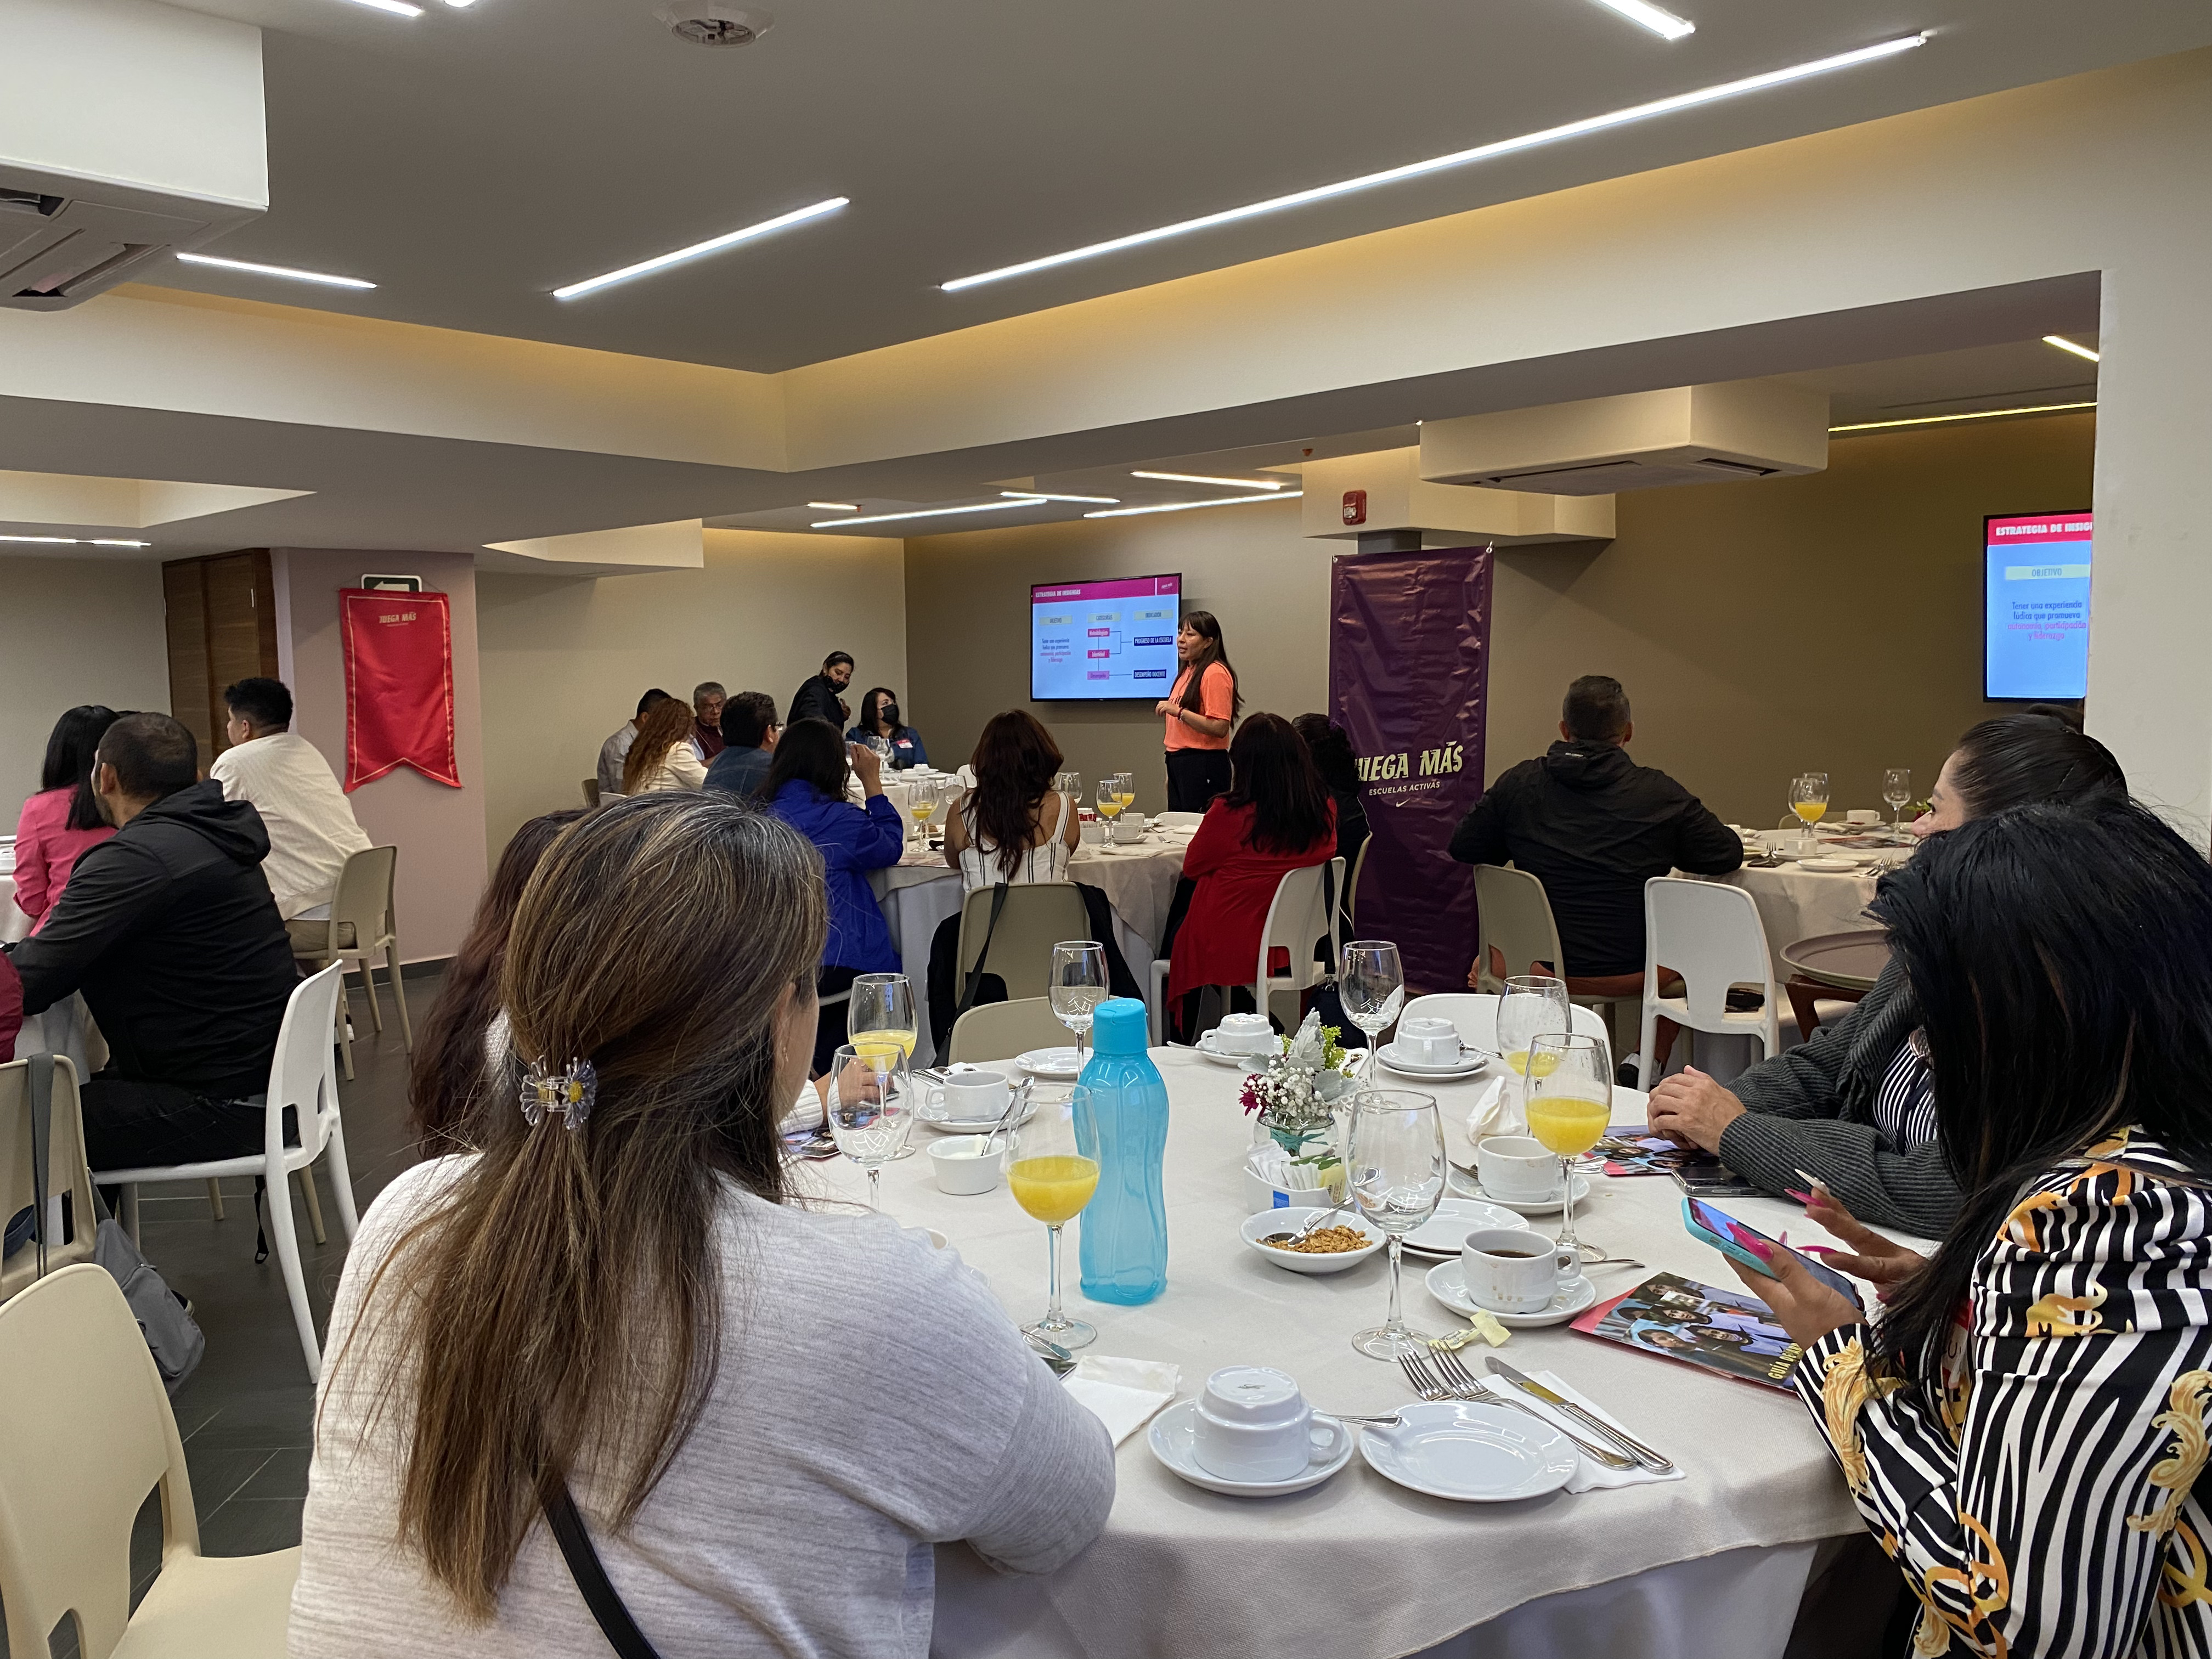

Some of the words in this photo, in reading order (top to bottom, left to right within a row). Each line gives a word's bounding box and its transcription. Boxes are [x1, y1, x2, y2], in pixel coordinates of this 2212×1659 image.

[1996, 524, 2047, 536] ESTRATEGIA
[2050, 524, 2062, 533] DE
[2032, 568, 2062, 577] OBJETIVO
[2012, 601, 2029, 610] Tener
[379, 614, 399, 624] JUEGA
[2047, 612, 2080, 620] promueva
[2034, 631, 2064, 641] liderazgo
[1355, 752, 1409, 782] UEGA
[1419, 741, 1464, 776] MÁS
[1369, 785, 1407, 795] ESCUELAS
[1408, 781, 1441, 792] ACTIVAS
[1768, 1361, 1791, 1380] GUÍA
